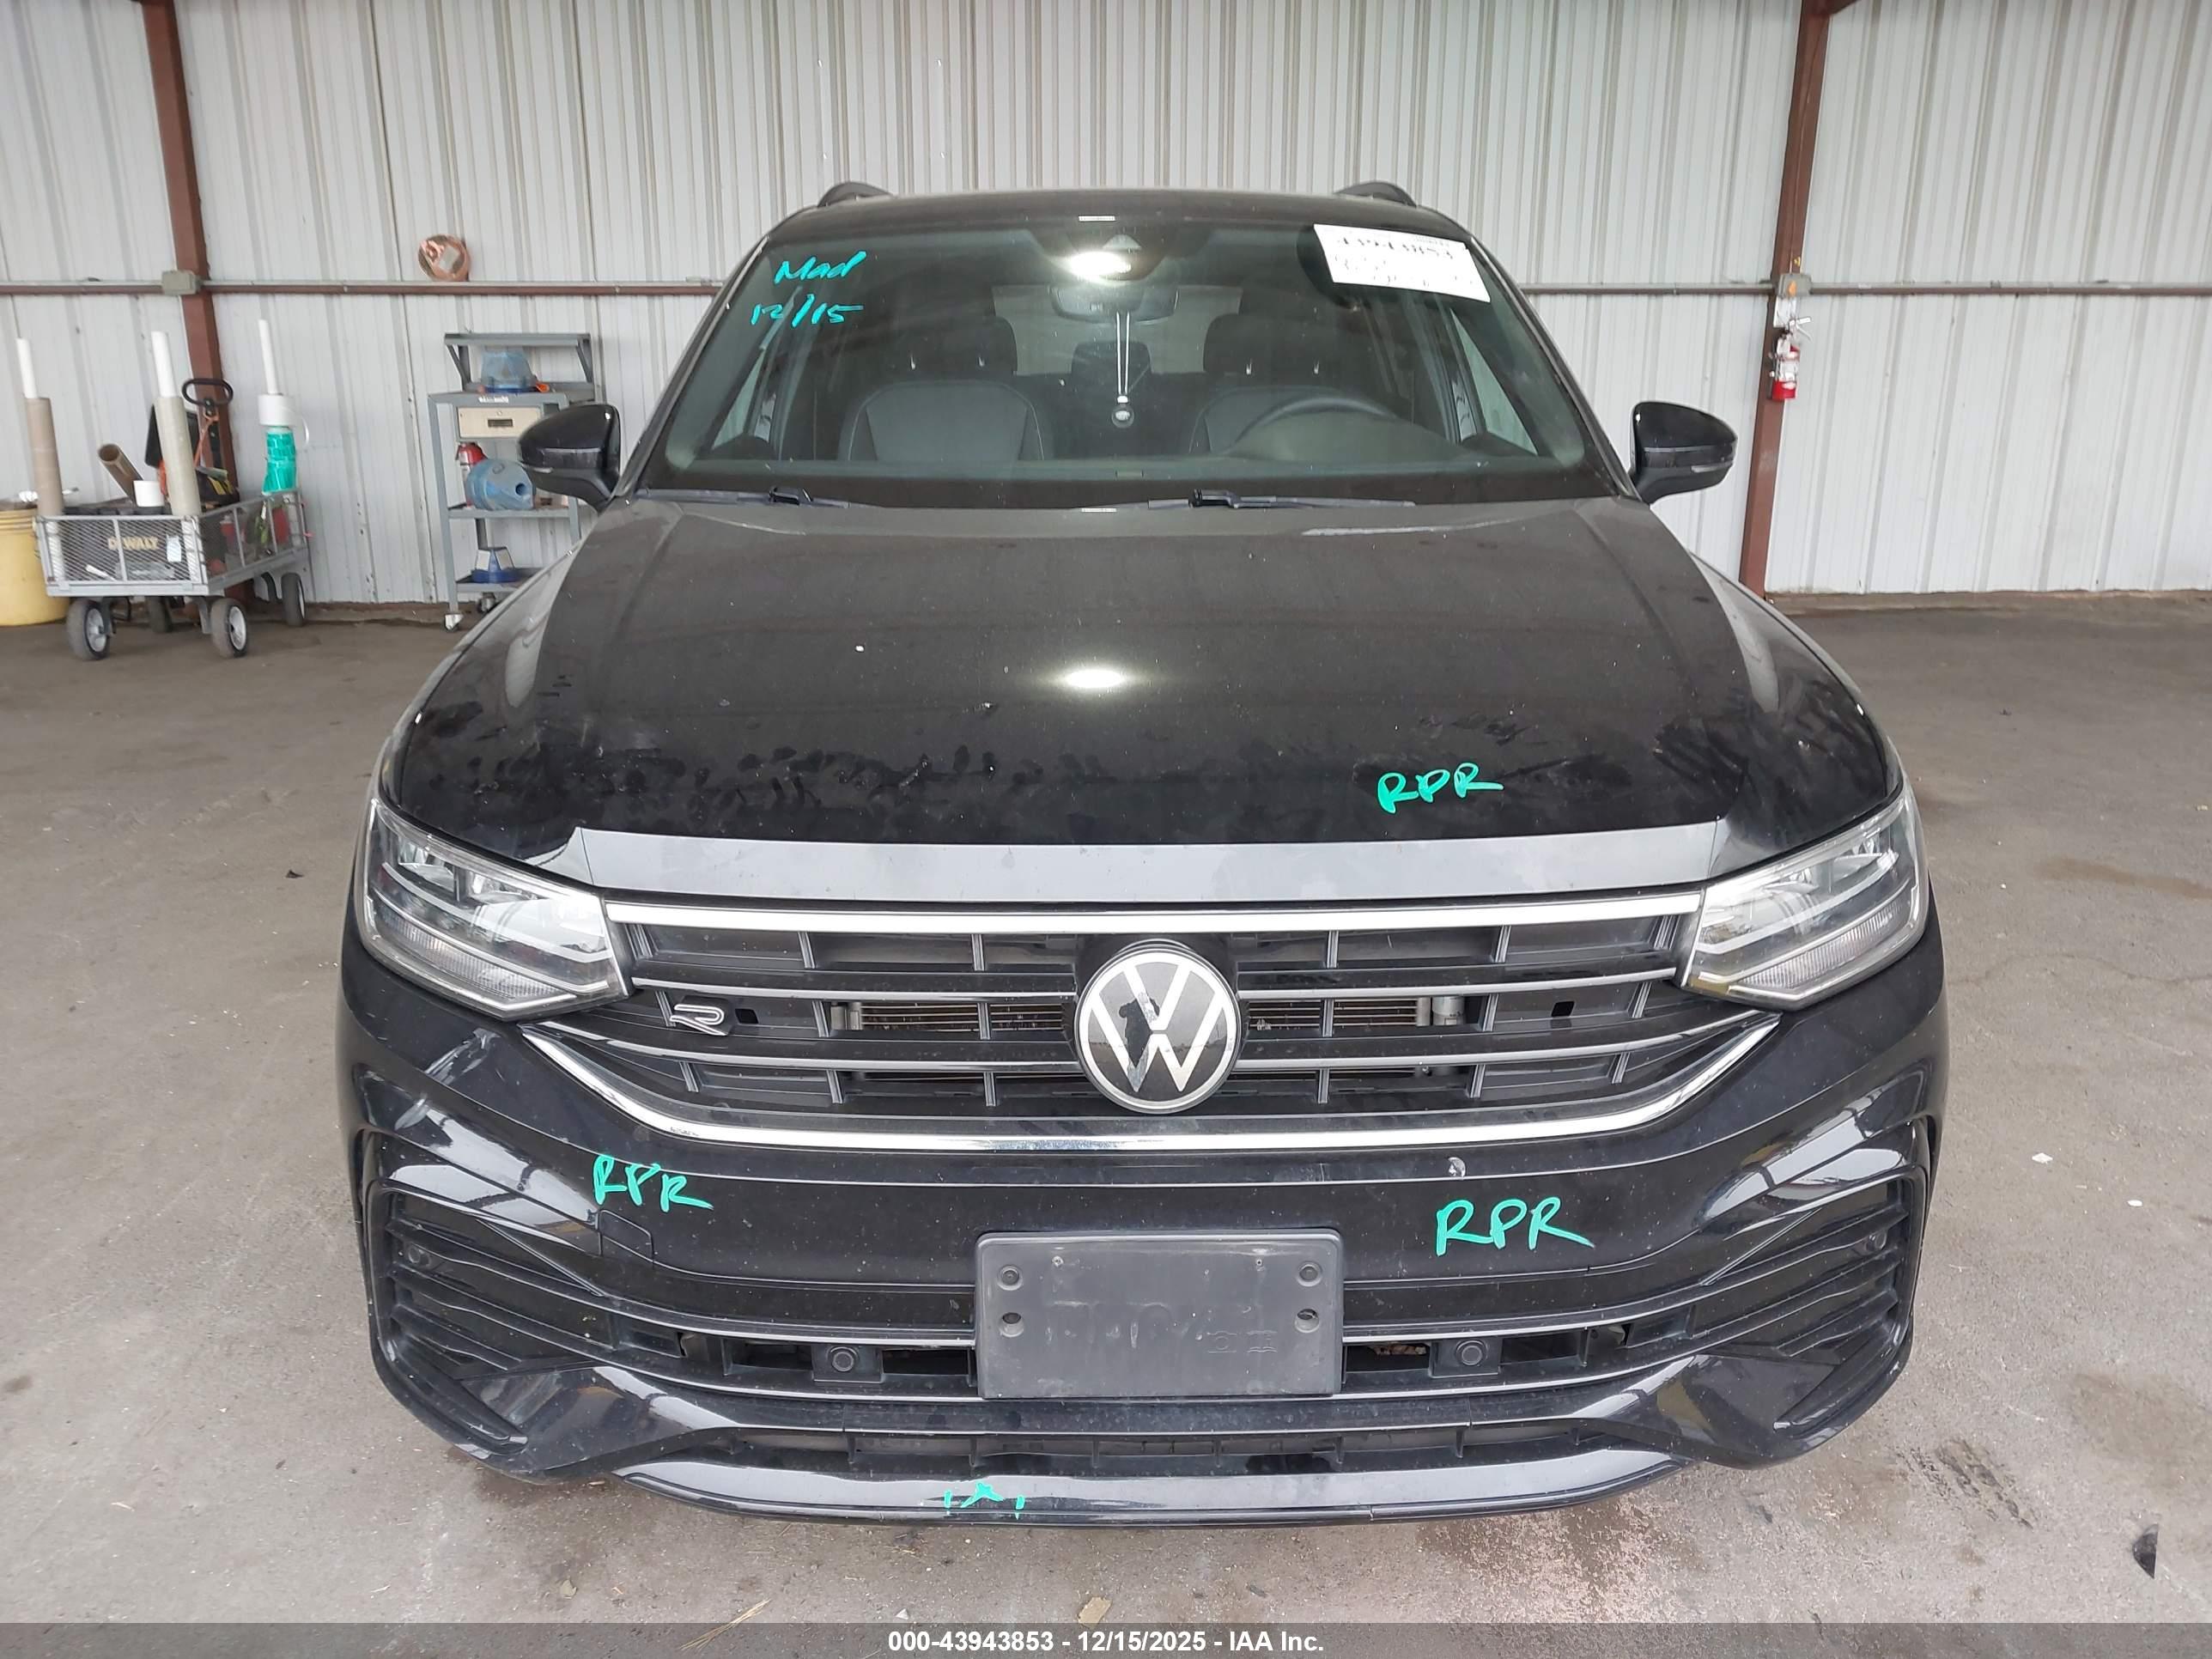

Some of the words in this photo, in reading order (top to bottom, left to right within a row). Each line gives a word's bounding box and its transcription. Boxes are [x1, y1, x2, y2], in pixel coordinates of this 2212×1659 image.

[750, 294, 864, 328] 12/15
[108, 536, 159, 550] DWALT
[1377, 763, 1504, 814] RPR
[592, 1155, 714, 1212] RPR
[1436, 1196, 1595, 1256] RPR
